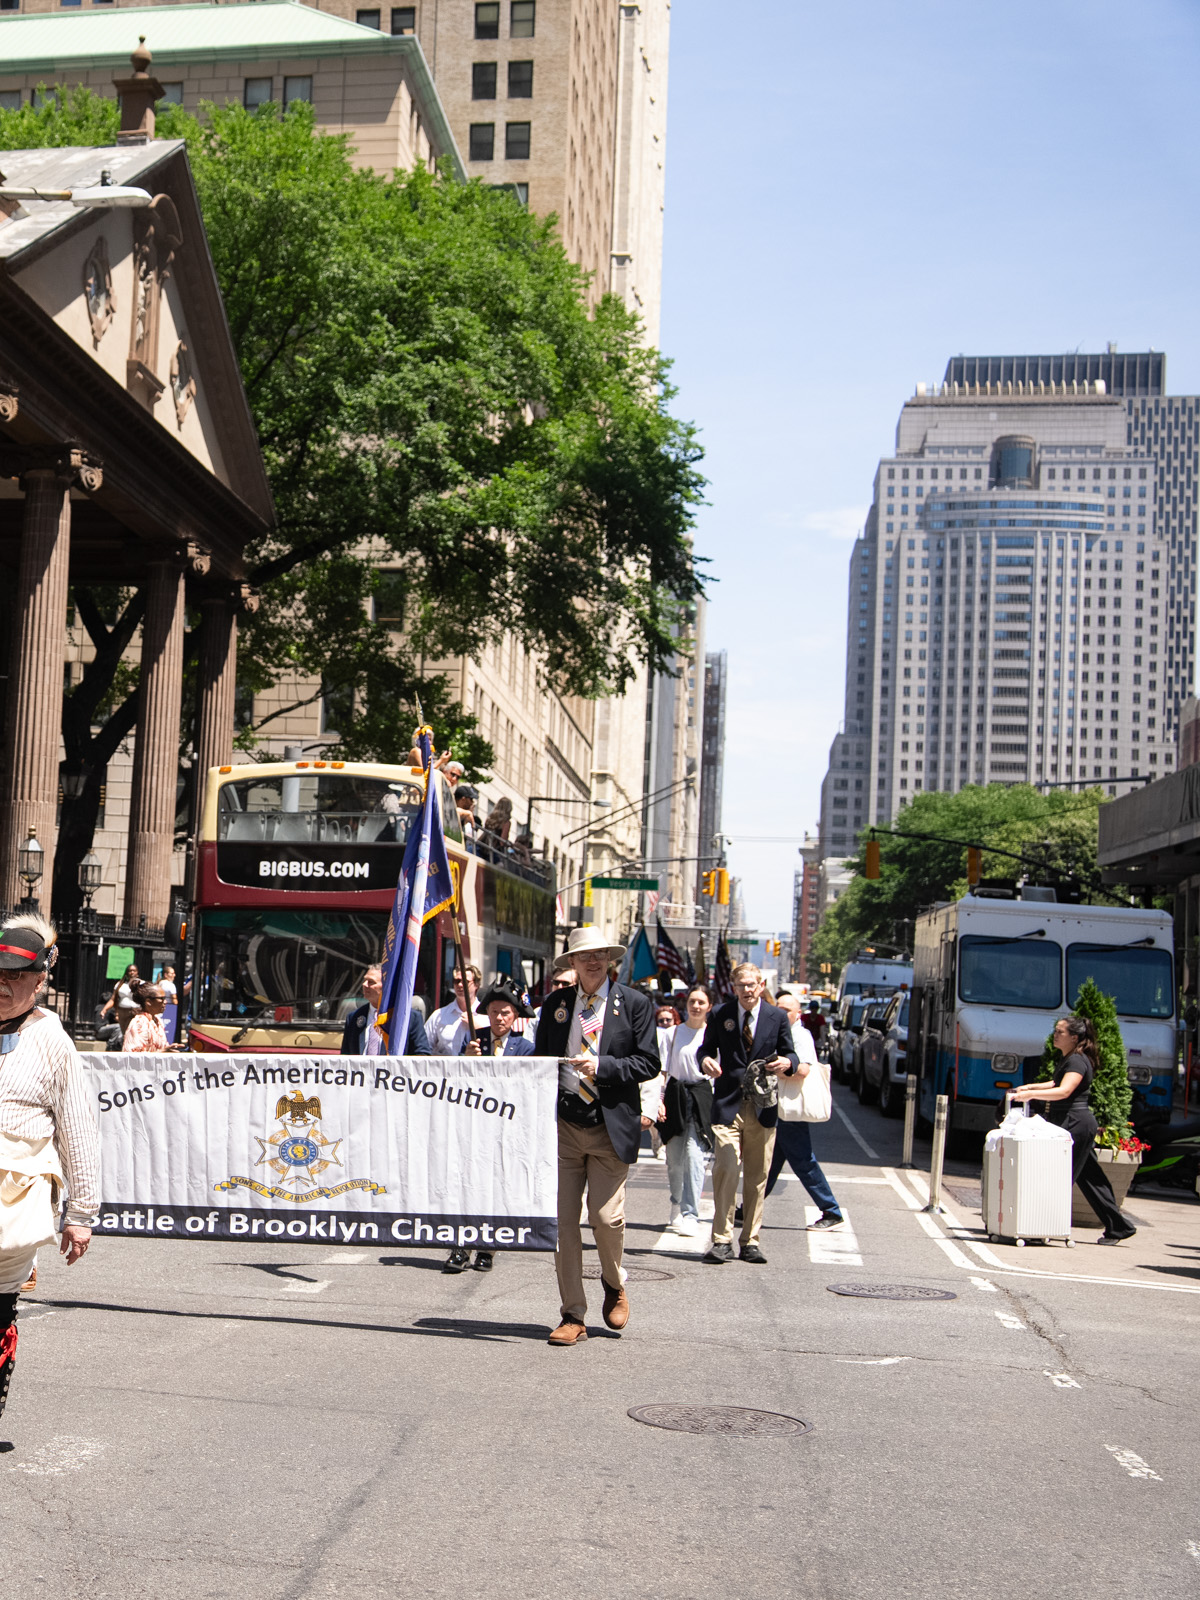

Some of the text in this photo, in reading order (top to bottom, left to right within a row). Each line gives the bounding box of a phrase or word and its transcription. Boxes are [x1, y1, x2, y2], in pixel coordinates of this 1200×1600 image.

[259, 861, 370, 879] BIGBUS.COM
[608, 879, 632, 889] Vesey
[98, 1062, 517, 1120] Sons of the American Revolution
[234, 1177, 253, 1187] SONS
[273, 1187, 326, 1202] THE AMERICAN
[185, 1211, 219, 1233] of
[229, 1213, 379, 1243] Brooklyn
[391, 1218, 532, 1247] Chapter
